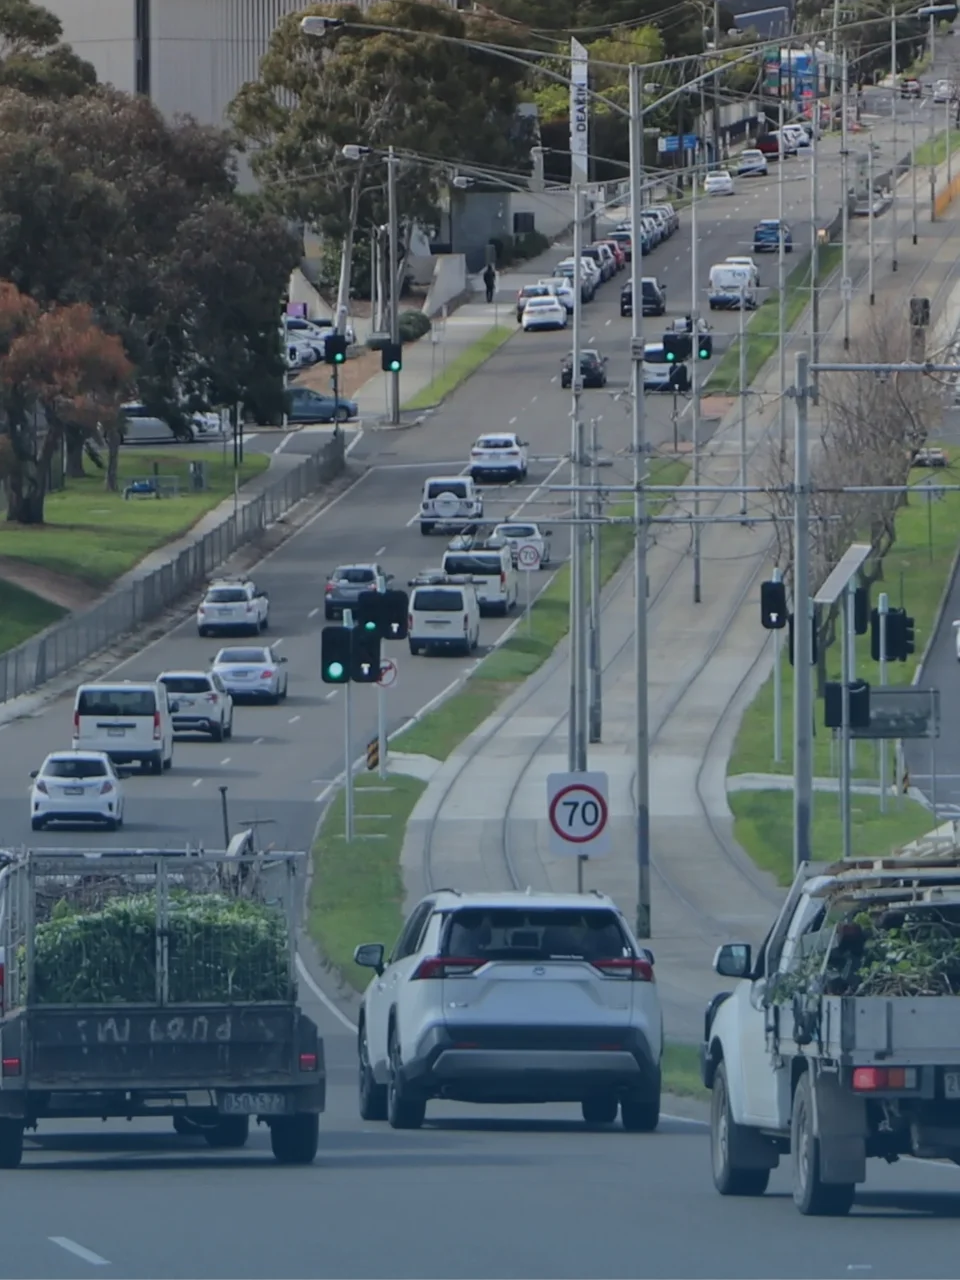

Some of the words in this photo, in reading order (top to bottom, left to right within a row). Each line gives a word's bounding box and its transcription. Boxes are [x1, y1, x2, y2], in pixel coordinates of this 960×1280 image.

[576, 82, 587, 133] DEAKIN
[522, 550, 537, 560] 70
[562, 801, 599, 827] 70
